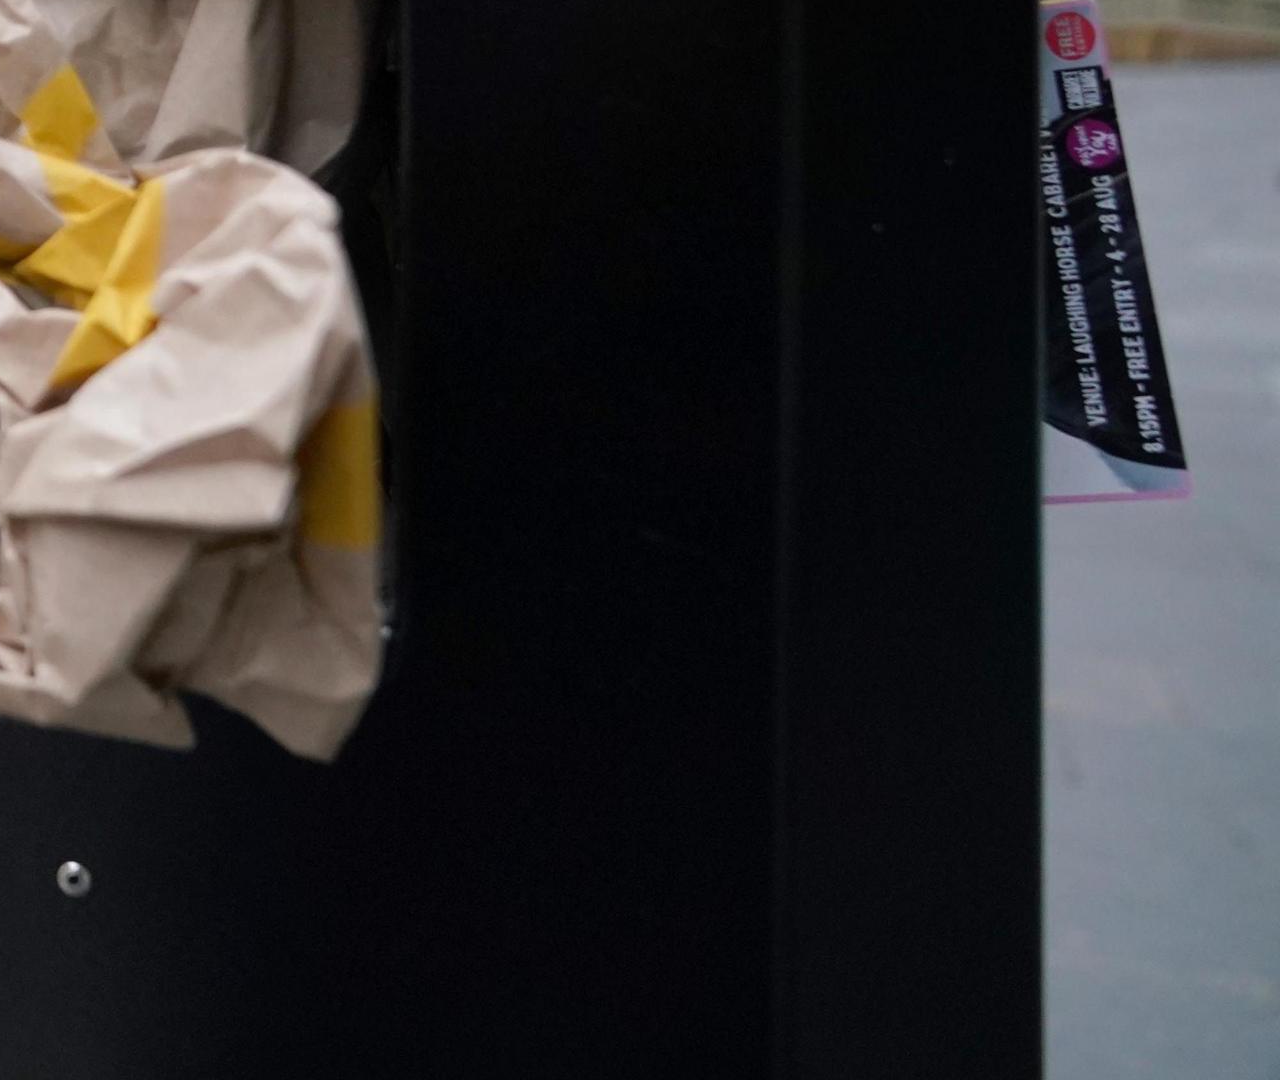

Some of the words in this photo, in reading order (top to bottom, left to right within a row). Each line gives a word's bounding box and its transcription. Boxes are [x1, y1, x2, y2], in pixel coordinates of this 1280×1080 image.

[1092, 174, 1119, 211] AUG
[1098, 214, 1123, 234] 28
[1051, 224, 1080, 281] HORSE
[1106, 249, 1128, 262] 4
[1061, 283, 1097, 364] LAUGHING
[1111, 278, 1142, 333] ENTRY
[1122, 336, 1152, 380] FREE
[1079, 365, 1108, 427] VENUE:
[1133, 394, 1166, 454] 8.15PM
